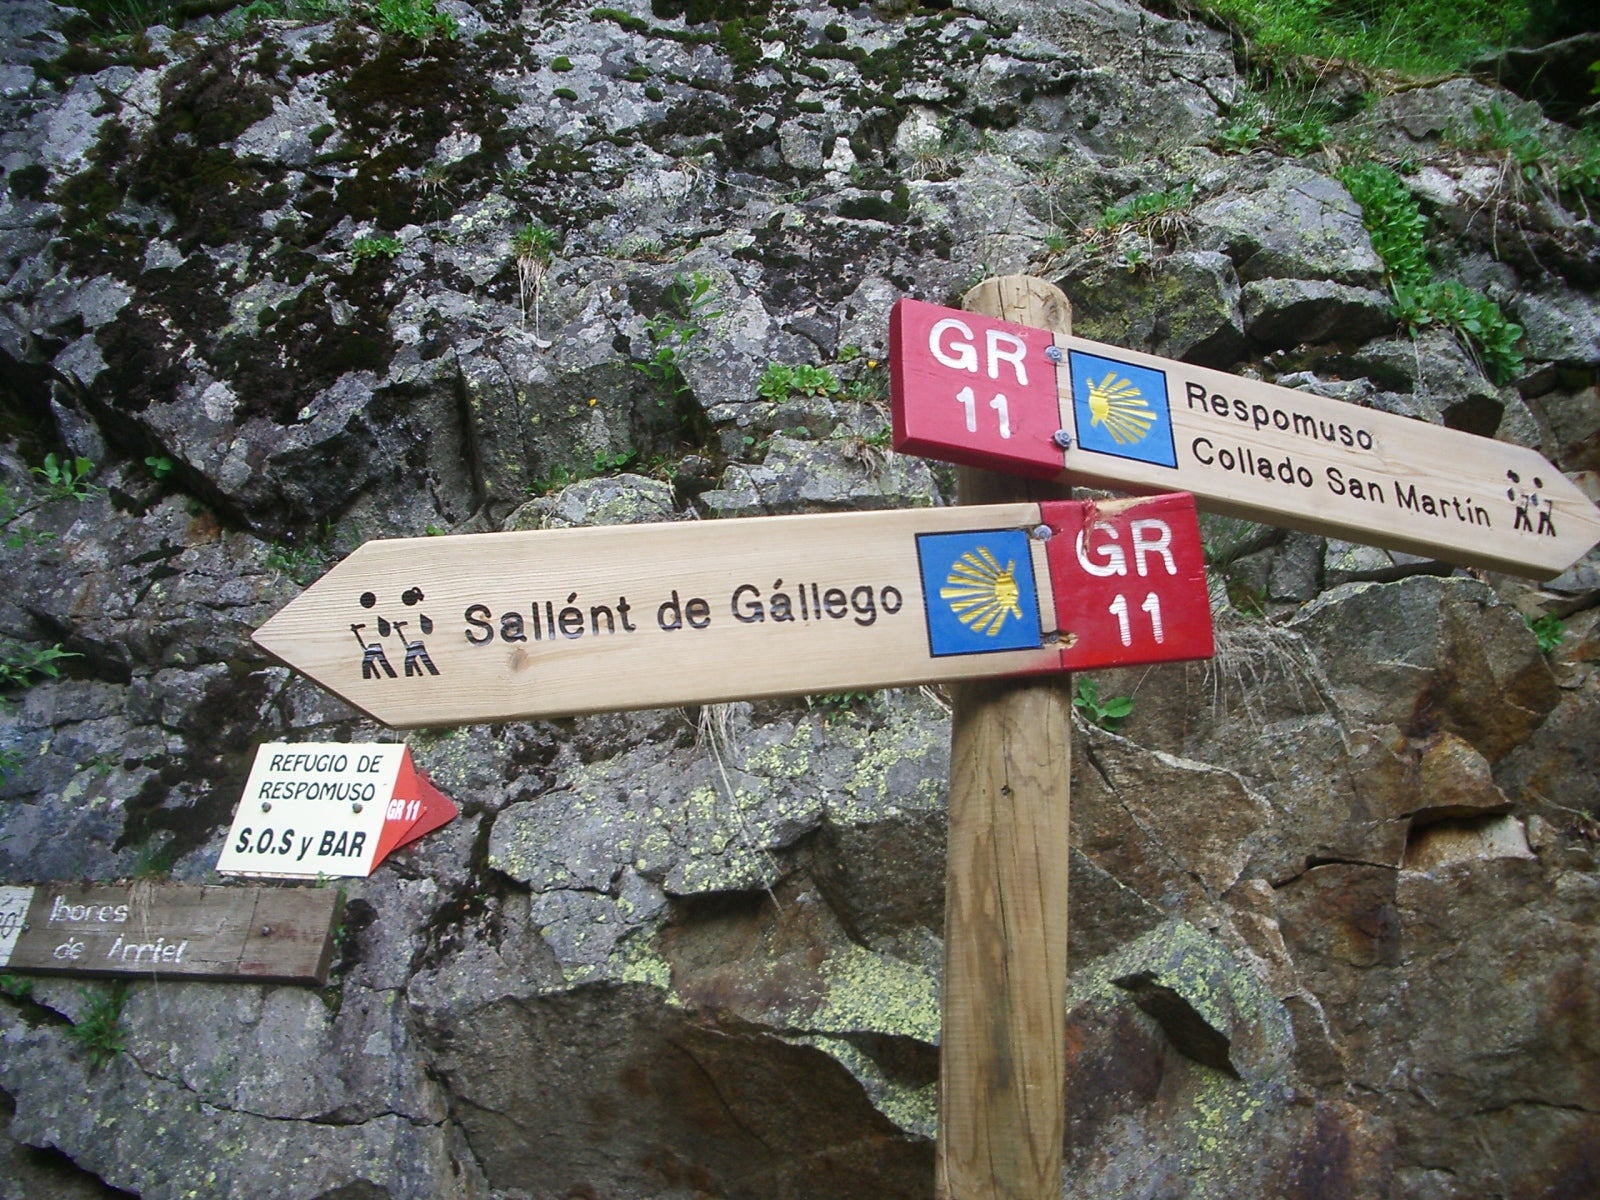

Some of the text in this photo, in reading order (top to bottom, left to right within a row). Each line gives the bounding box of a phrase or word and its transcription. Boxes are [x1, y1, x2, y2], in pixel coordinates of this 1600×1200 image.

[928, 318, 1028, 386] GR
[956, 386, 1011, 439] 11
[1185, 381, 1373, 451] Respomuso
[1192, 436, 1491, 527] Collado San Martín
[1075, 518, 1178, 577] GR
[464, 578, 903, 647] Sallént de Gállego
[1108, 591, 1164, 648] 11
[258, 781, 376, 802] RESPOMUSO
[269, 754, 384, 773] REFUGIO DE
[386, 798, 420, 821] GR 11
[235, 827, 367, 861] S.O.S y BAR
